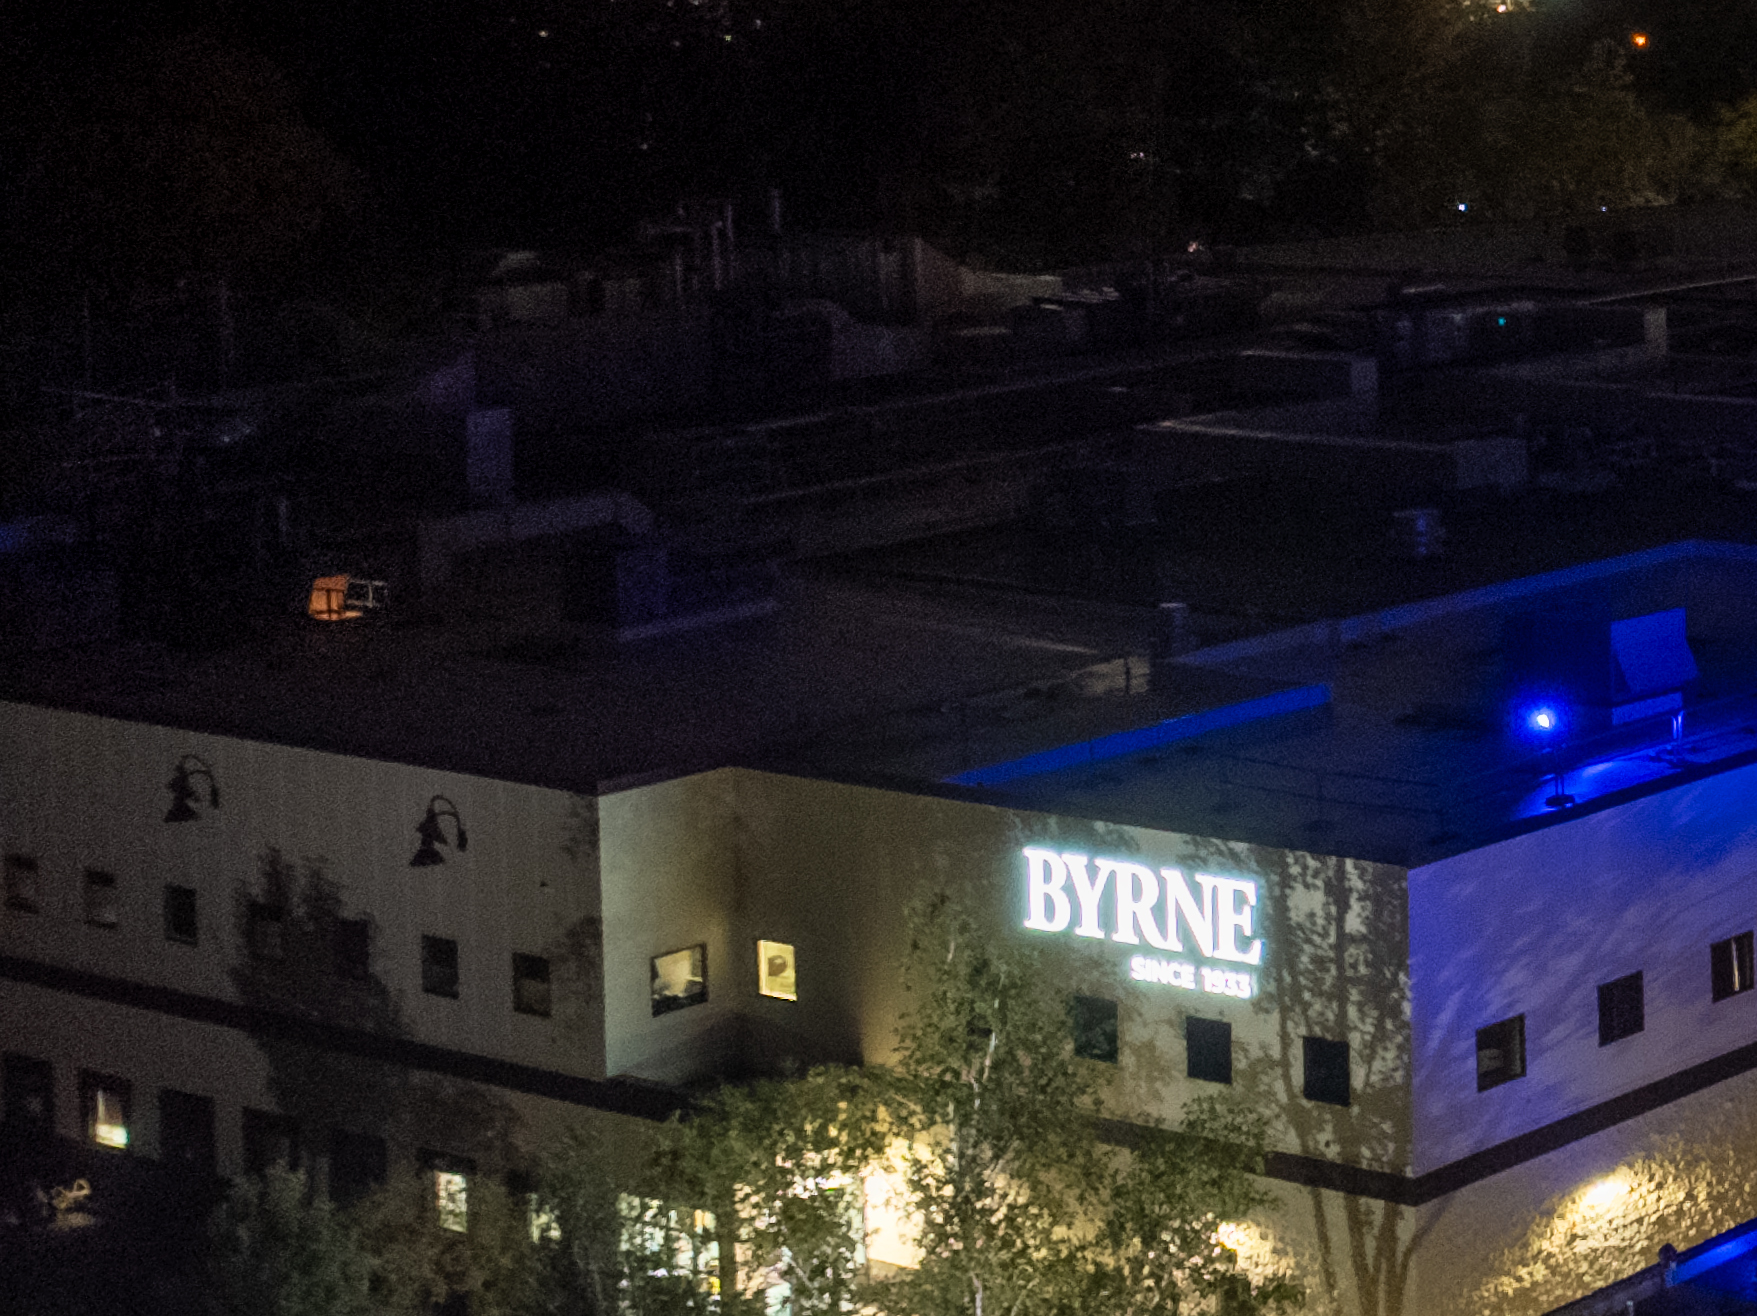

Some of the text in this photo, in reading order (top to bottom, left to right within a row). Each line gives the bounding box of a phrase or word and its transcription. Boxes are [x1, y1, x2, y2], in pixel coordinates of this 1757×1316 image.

[1022, 846, 1262, 966] BYRNE
[1130, 954, 1252, 1000] SINCE 1933
